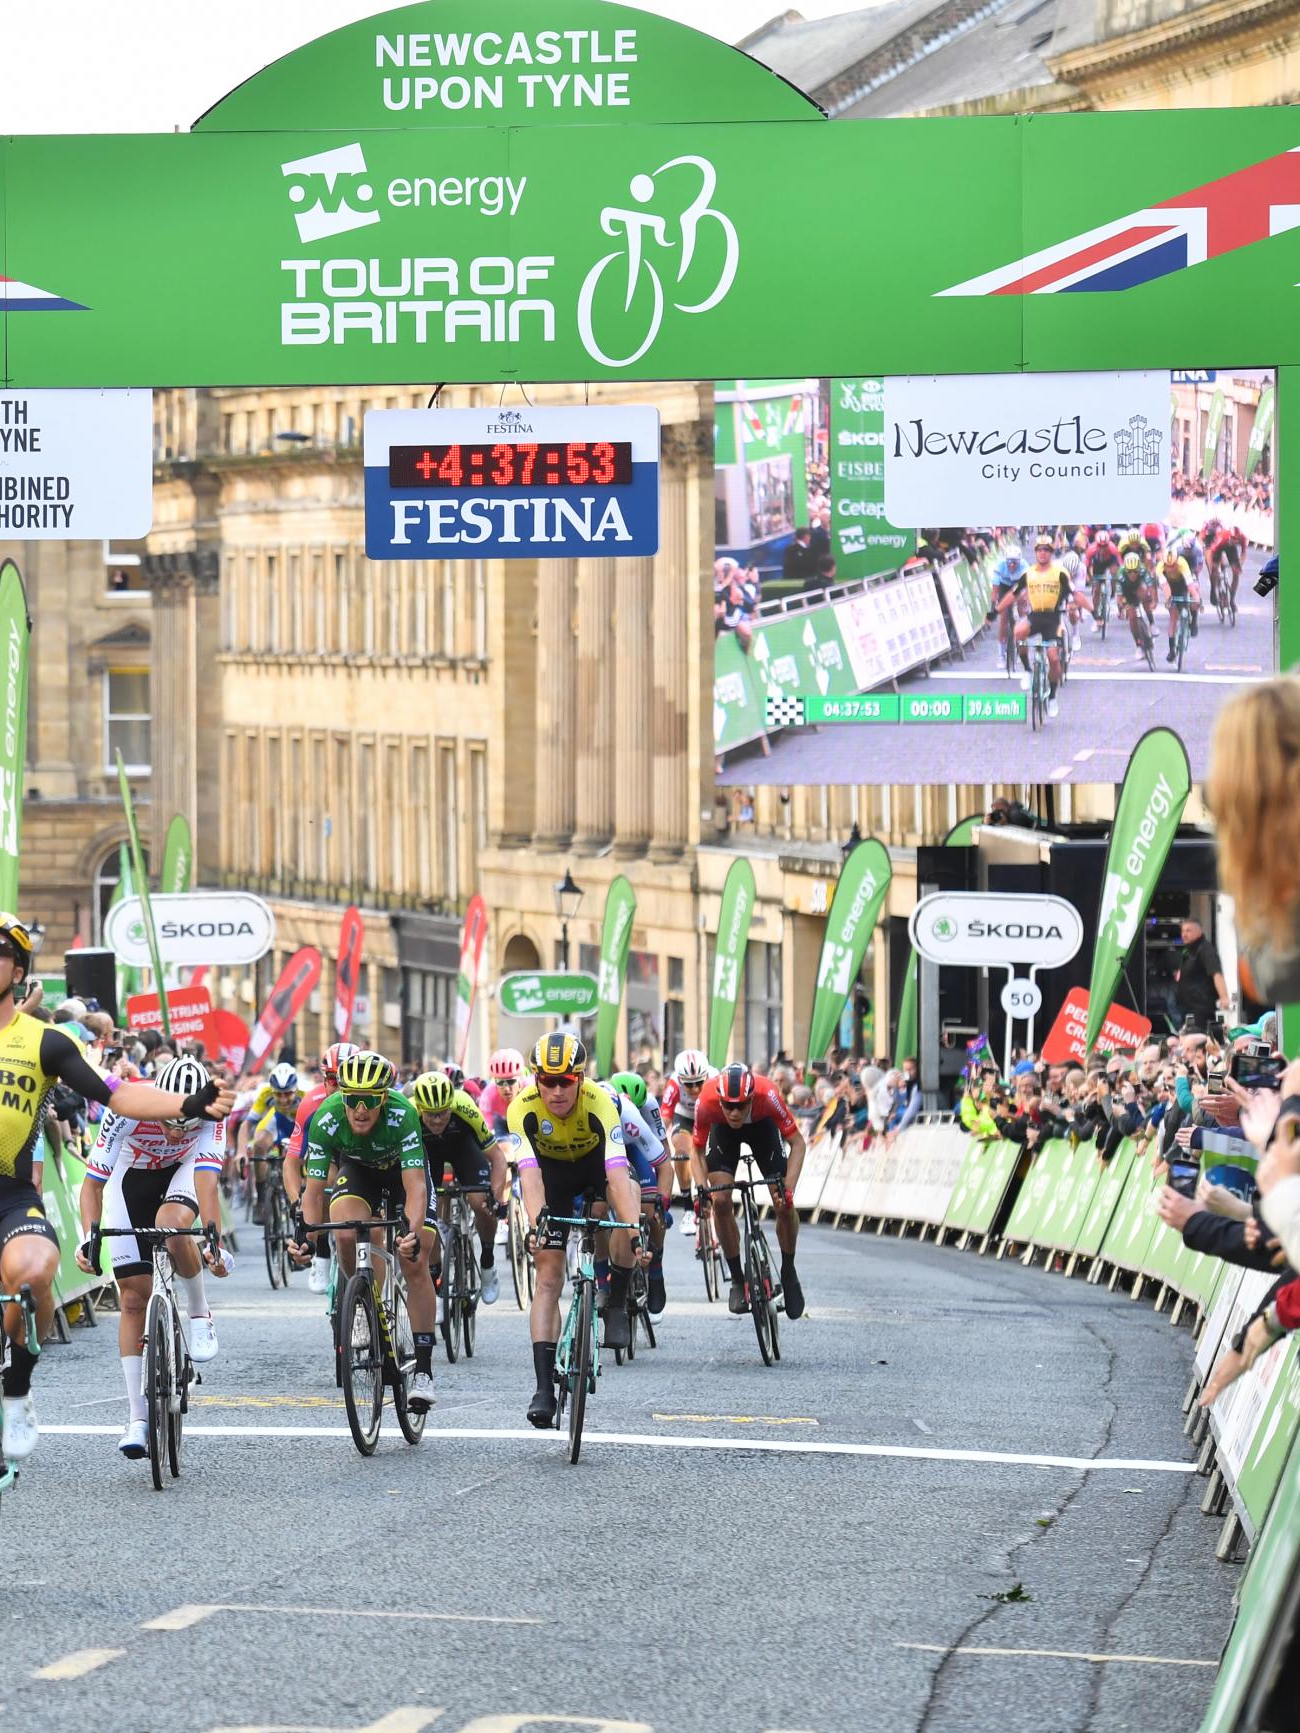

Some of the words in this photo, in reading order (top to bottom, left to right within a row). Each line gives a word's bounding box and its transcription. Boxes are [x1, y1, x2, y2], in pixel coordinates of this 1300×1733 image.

[375, 29, 638, 68] NEWCASTLE
[383, 75, 502, 111] UPON
[518, 72, 631, 108] TYNE
[387, 175, 527, 217] energy
[280, 257, 459, 298] TOUR
[469, 255, 555, 295] OF
[280, 299, 556, 345] BRITAIN
[486, 424, 534, 434] FESTINA
[892, 415, 1108, 459] Newcastle
[416, 442, 616, 486] +4:37:53
[981, 463, 1022, 482] City
[1029, 461, 1106, 479] Council
[389, 497, 633, 545] FESTINA
[5, 617, 22, 758] energy
[823, 701, 881, 718] 04:37:53
[910, 701, 951, 718] 00:00
[968, 700, 993, 718] 39.6
[993, 700, 1021, 718] km/h
[1126, 772, 1174, 877] energy
[161, 912, 254, 940] ŠKODA
[727, 885, 749, 954] energy
[840, 868, 878, 943] energy
[966, 919, 1063, 941] ŠKODA
[546, 987, 594, 1005] energy
[1010, 992, 1034, 1007] 50
